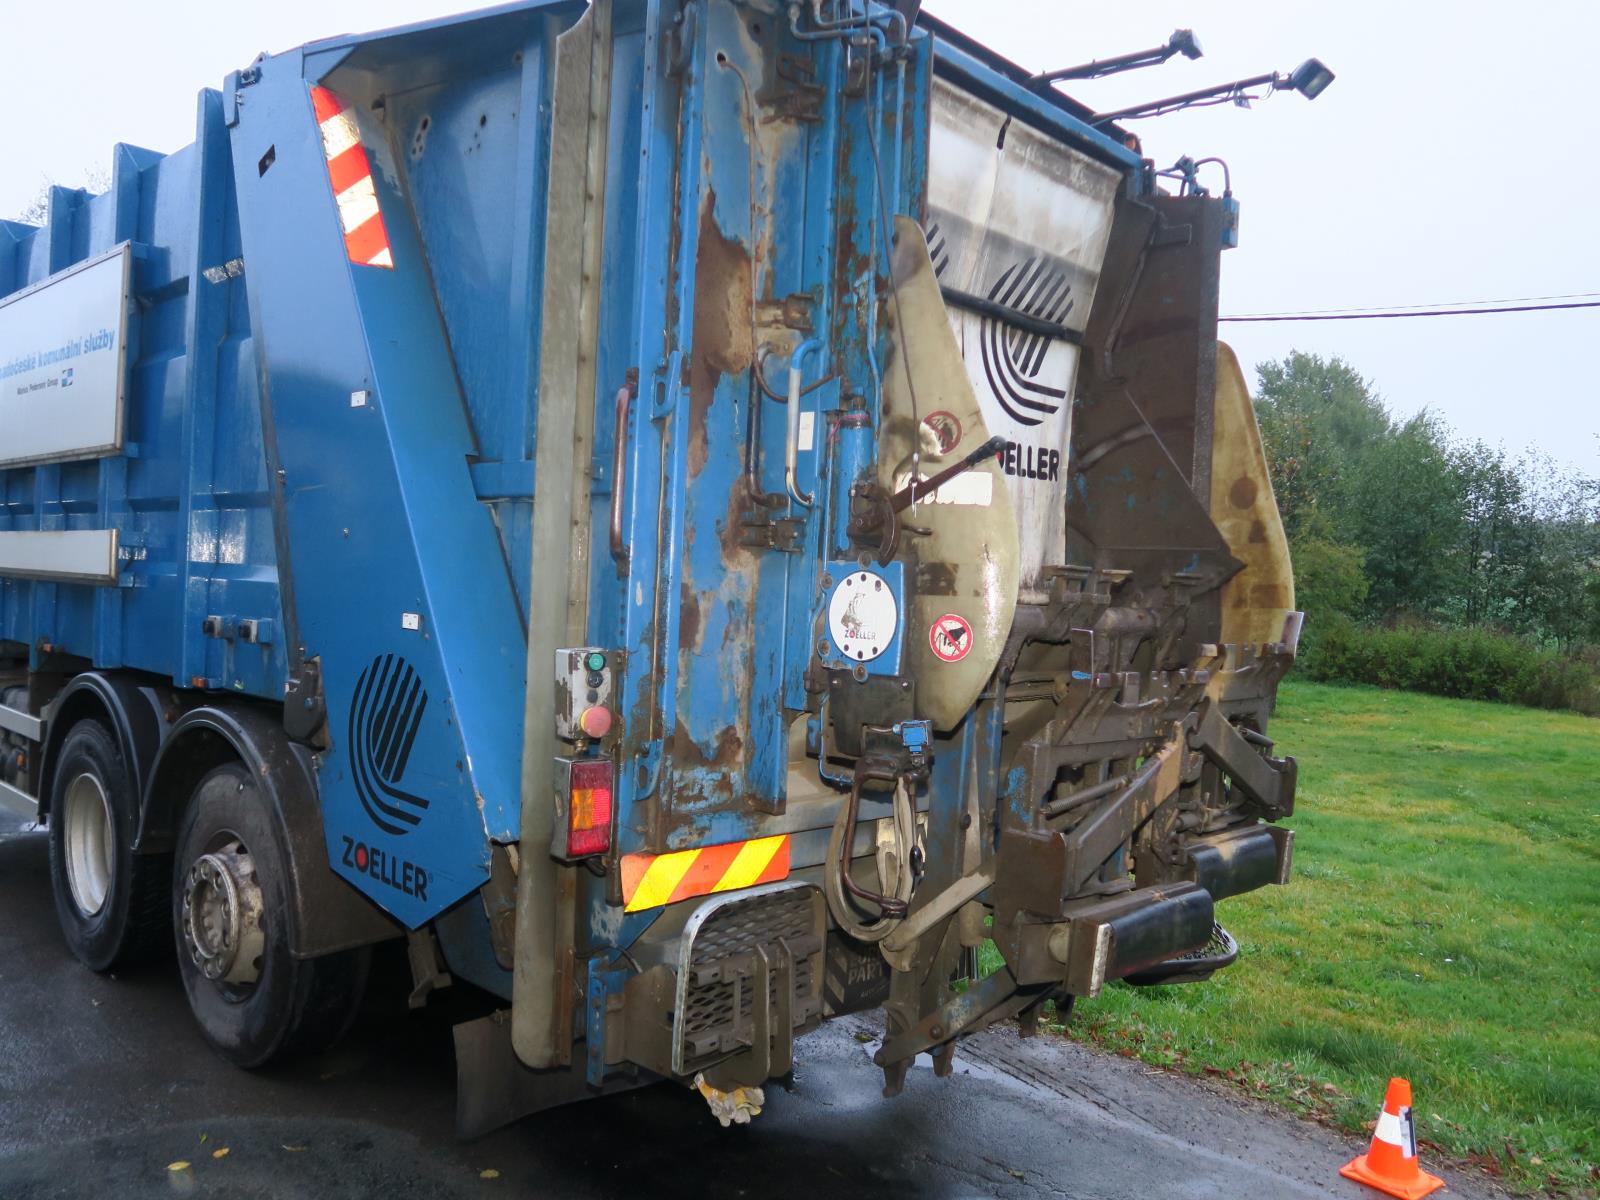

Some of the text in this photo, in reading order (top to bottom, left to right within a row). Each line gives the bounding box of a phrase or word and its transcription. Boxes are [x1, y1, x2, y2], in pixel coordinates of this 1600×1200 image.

[84, 329, 115, 354] služby
[844, 629, 876, 640] ZOELLER
[342, 834, 428, 902] ZOELLER
